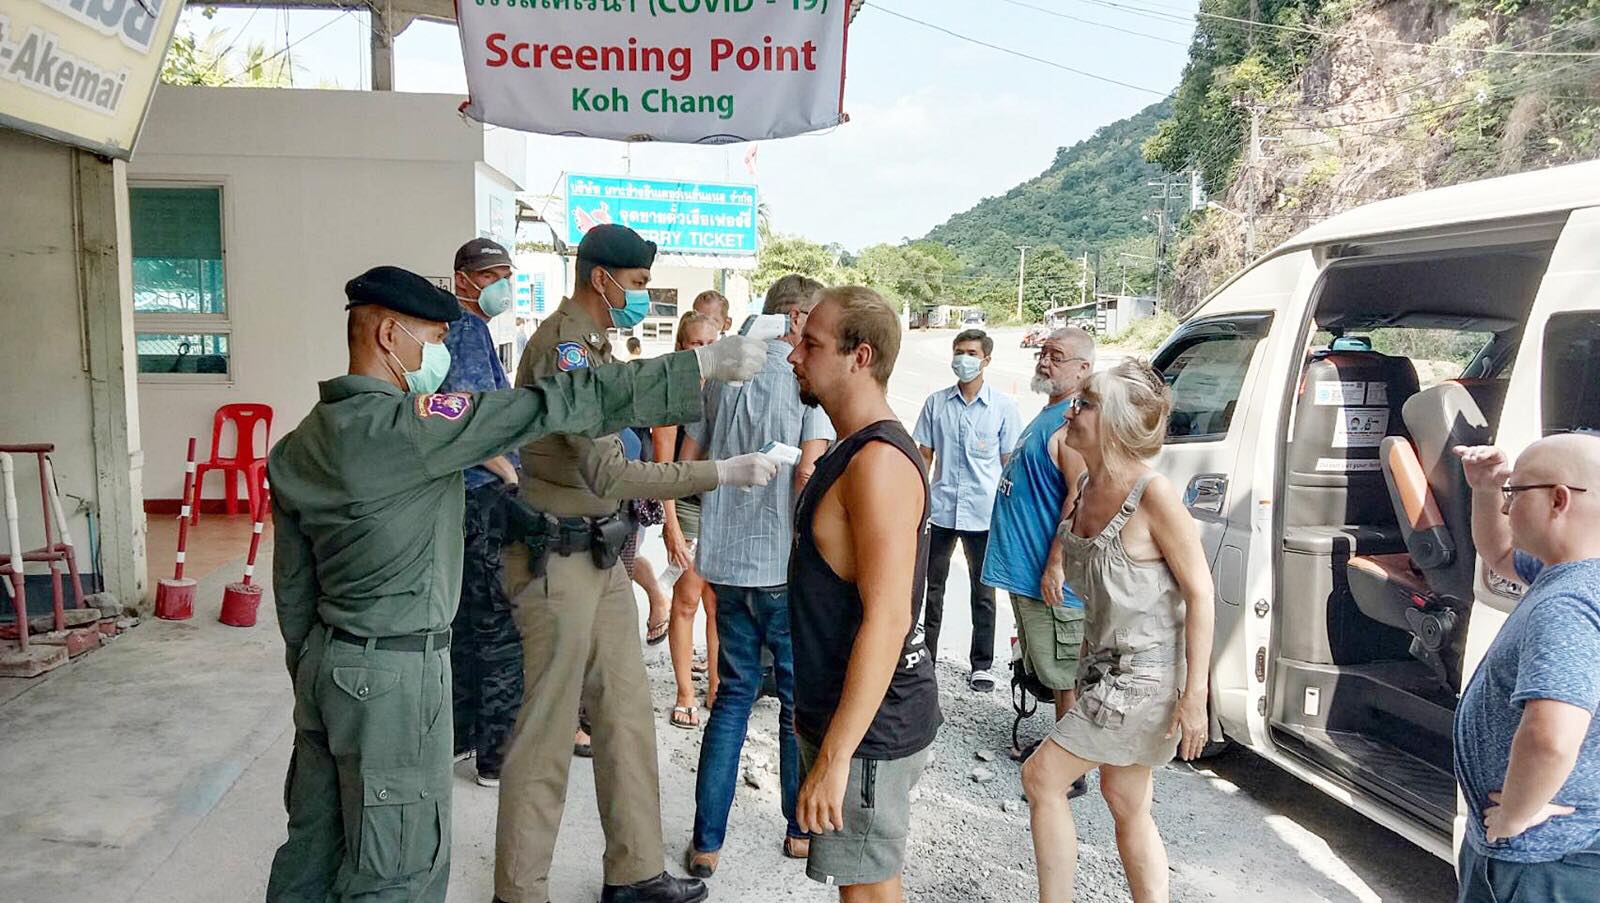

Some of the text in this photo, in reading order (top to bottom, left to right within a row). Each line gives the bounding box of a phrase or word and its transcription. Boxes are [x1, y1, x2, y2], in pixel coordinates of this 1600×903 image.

[0, 24, 126, 110] -Akemai
[486, 34, 817, 81] Screening Point
[573, 87, 733, 120] Koh Chang
[643, 230, 745, 248] ERRY TICKET
